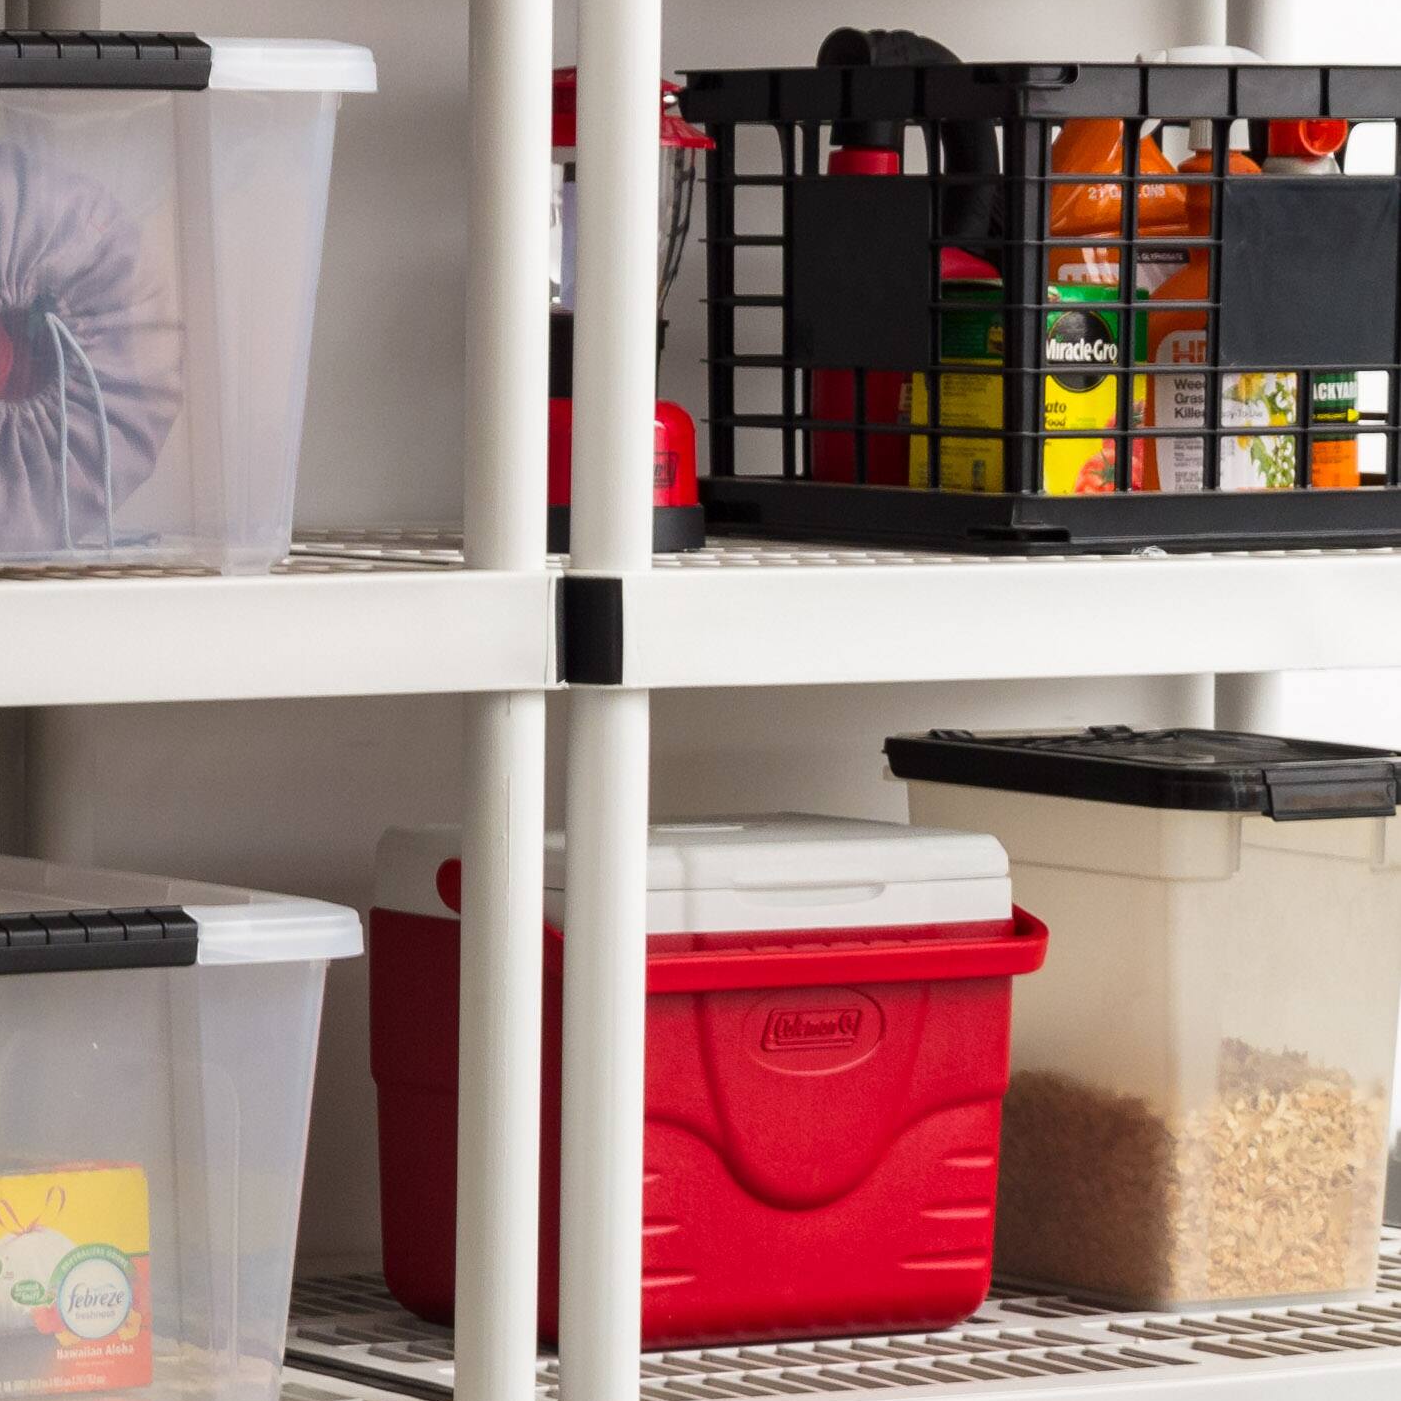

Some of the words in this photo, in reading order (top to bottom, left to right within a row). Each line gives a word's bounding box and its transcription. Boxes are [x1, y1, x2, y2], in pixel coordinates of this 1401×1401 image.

[1174, 378, 1206, 390] Wee
[1174, 393, 1205, 405] Gras
[1174, 407, 1206, 420] Kille
[67, 1282, 126, 1314] febreze
